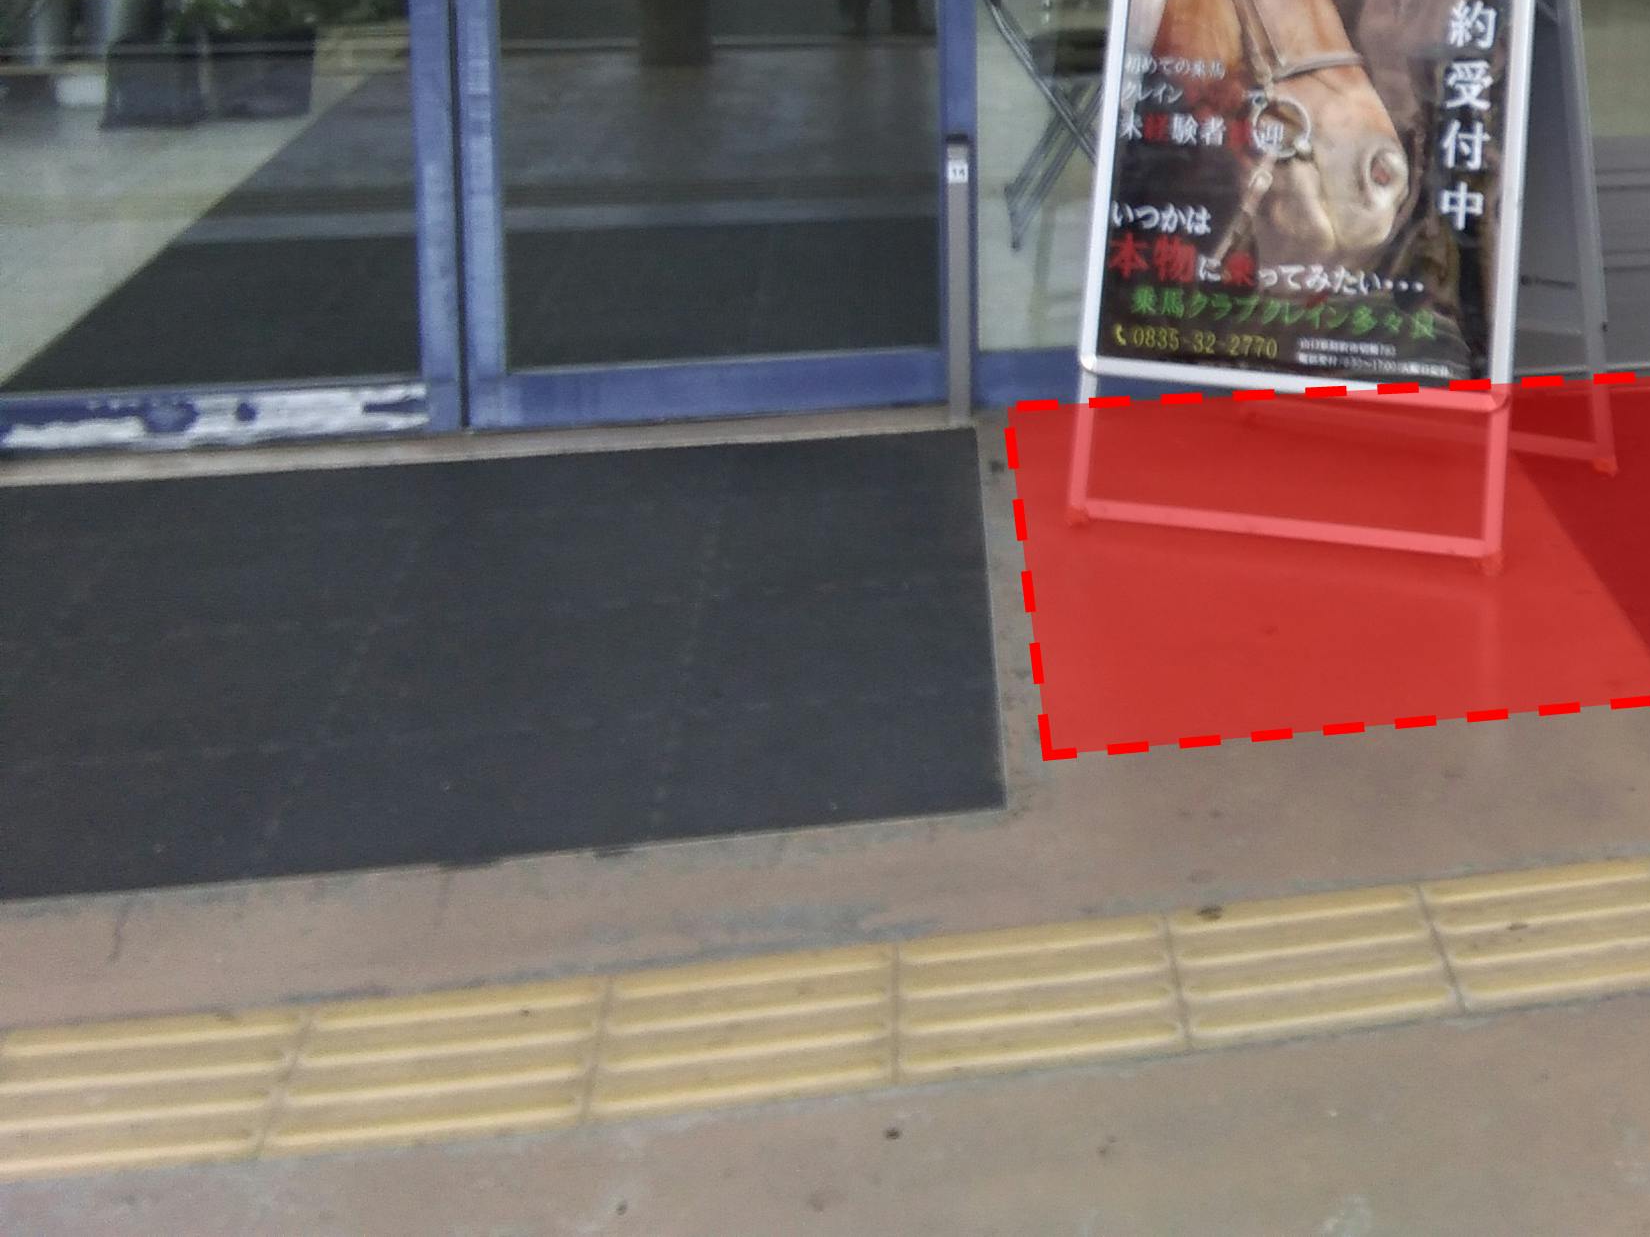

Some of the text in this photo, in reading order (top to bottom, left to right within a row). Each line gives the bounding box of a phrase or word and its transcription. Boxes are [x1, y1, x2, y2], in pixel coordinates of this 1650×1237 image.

[1119, 109, 1285, 151] 未験者迎
[1112, 201, 1211, 235] いつかは
